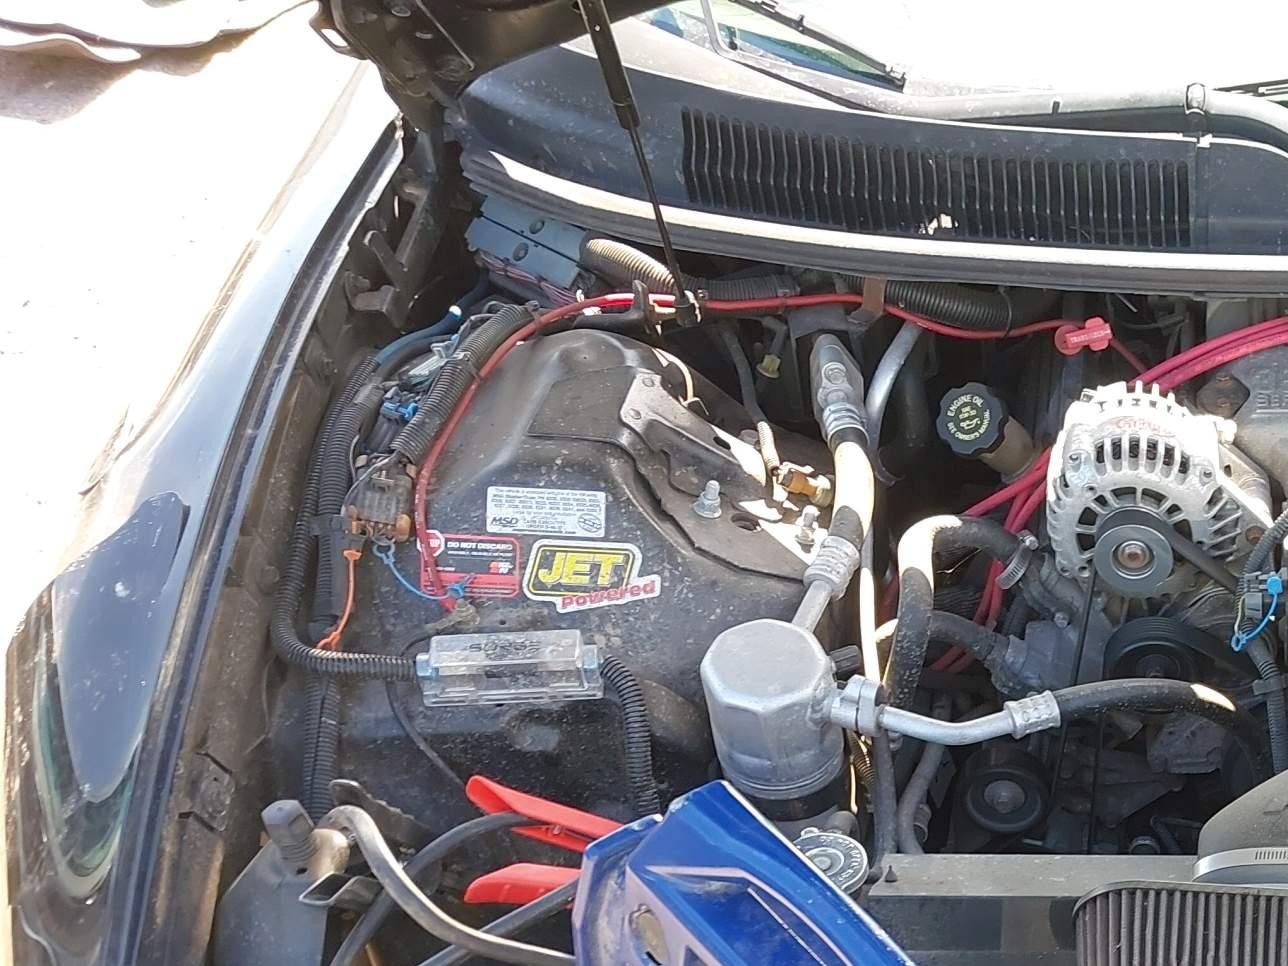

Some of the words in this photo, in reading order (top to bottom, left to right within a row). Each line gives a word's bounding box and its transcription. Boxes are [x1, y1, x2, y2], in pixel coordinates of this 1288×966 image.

[946, 394, 972, 417] ENGINE
[972, 395, 985, 408] OIL
[446, 541, 460, 549] DO
[461, 542, 476, 550] NOT
[477, 543, 513, 551] DISCARD
[537, 551, 625, 587] JET
